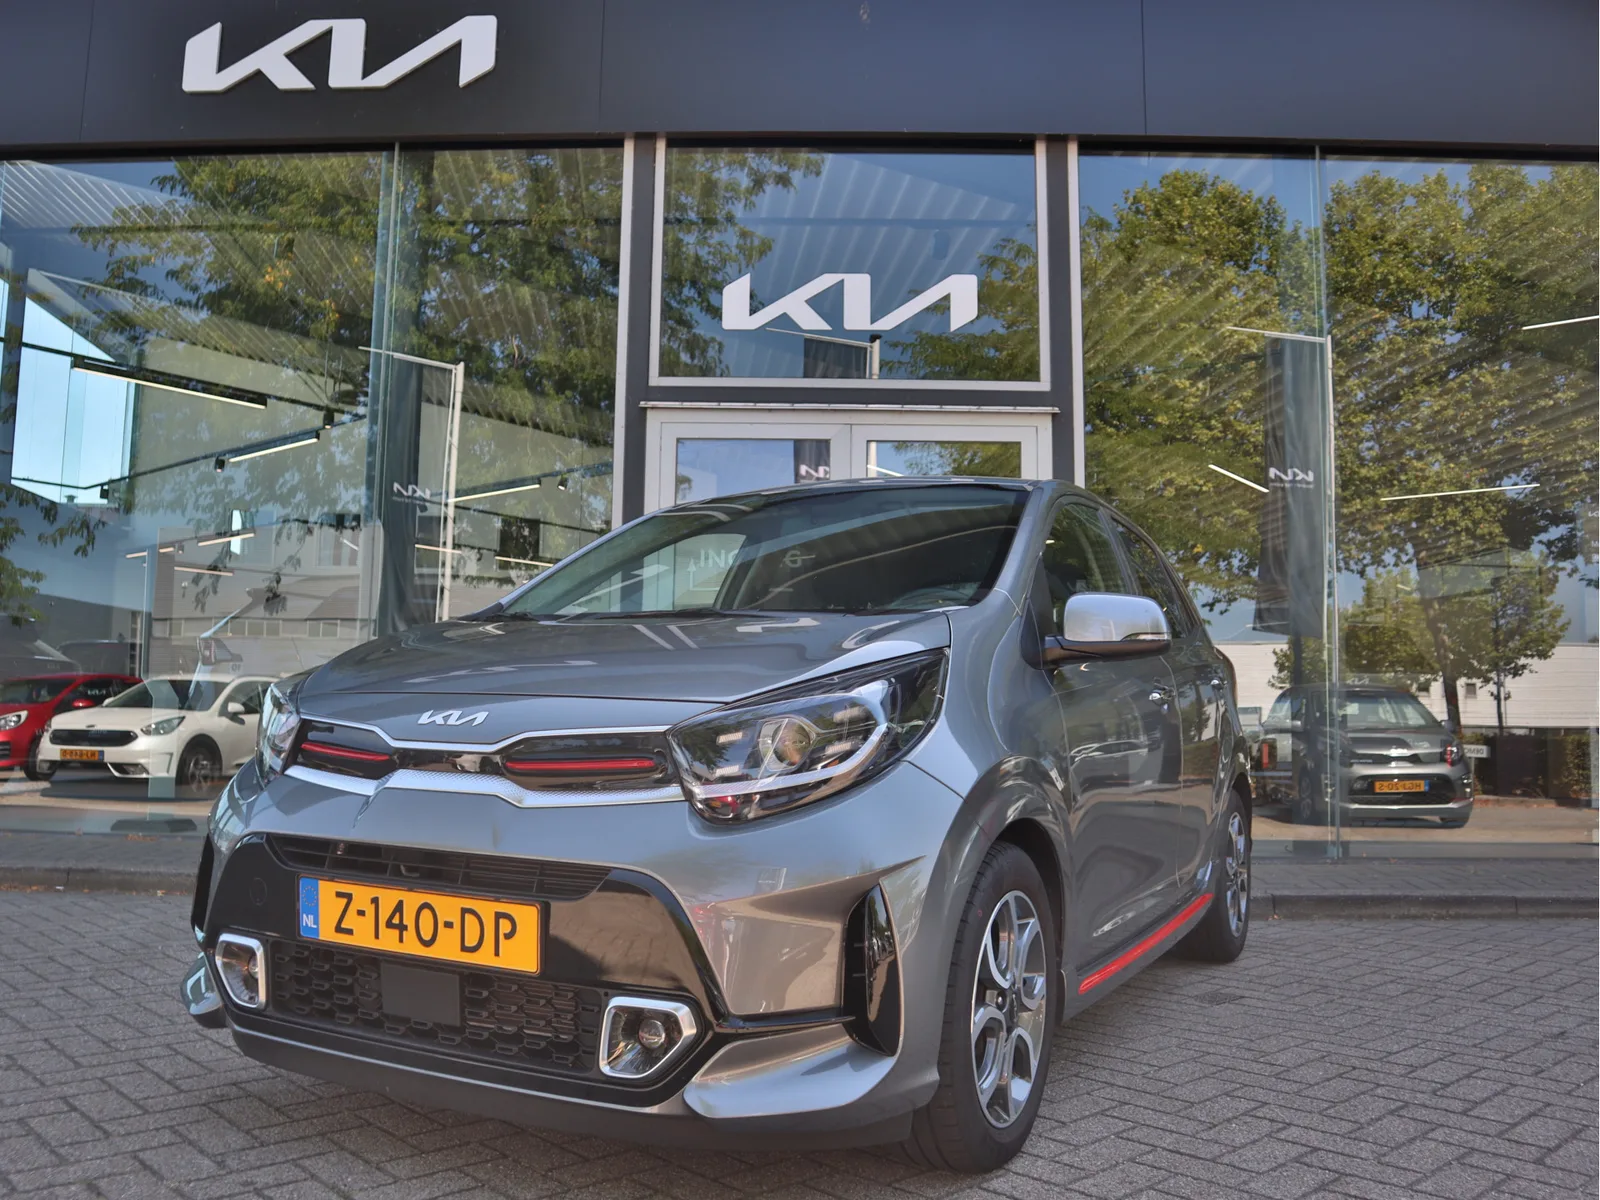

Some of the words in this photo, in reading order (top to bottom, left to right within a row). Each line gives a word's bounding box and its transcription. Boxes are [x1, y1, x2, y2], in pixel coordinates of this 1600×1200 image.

[182, 15, 497, 93] KIA
[722, 272, 978, 332] KIA
[417, 709, 490, 727] KIA
[302, 914, 317, 928] NL
[334, 890, 517, 957] Z-140-DP
